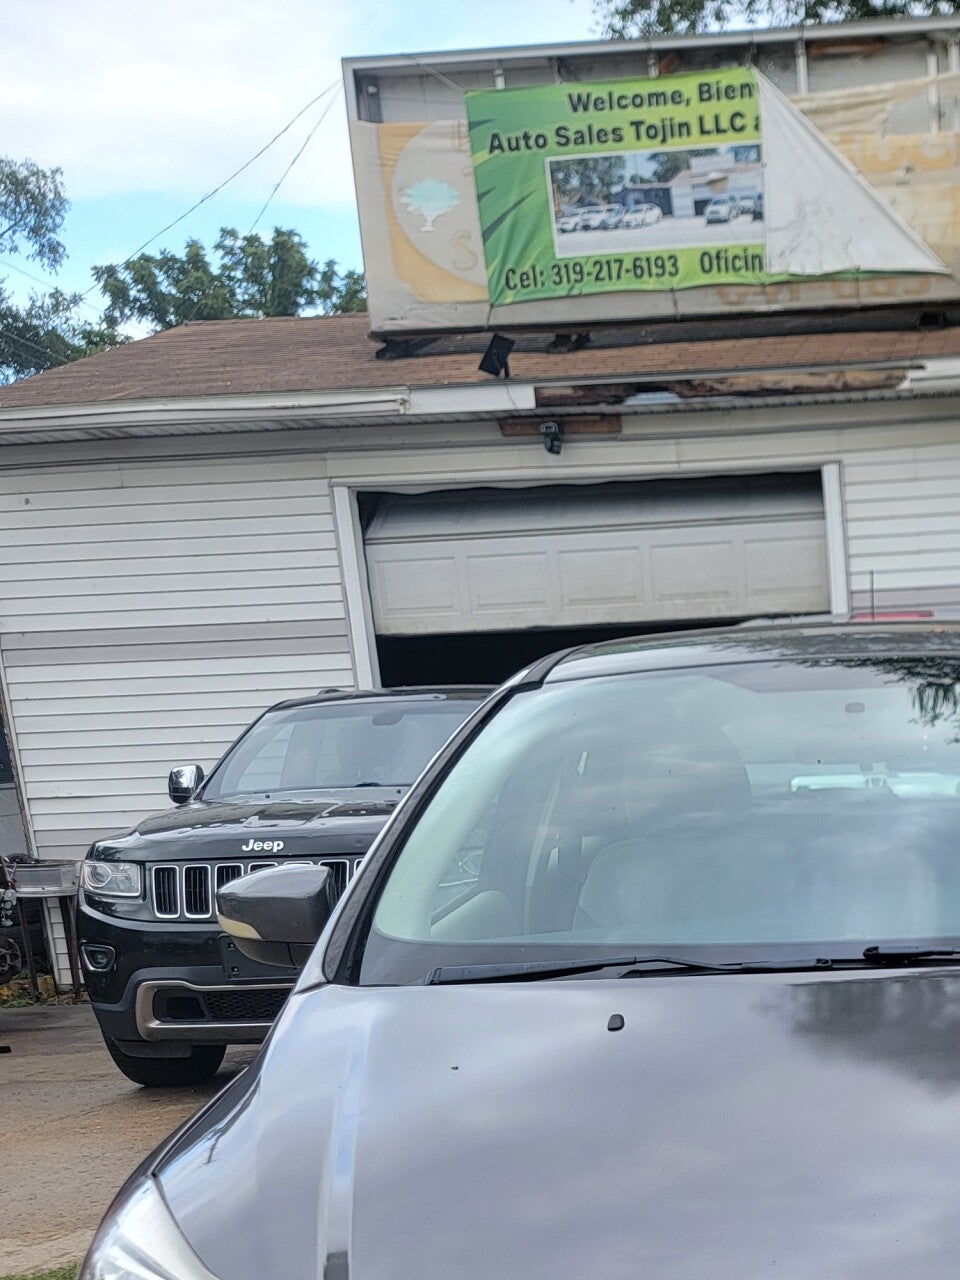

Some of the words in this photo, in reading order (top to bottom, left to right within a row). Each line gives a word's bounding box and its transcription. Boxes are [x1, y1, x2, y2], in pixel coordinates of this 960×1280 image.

[568, 89, 691, 113] Welcome,
[698, 79, 760, 102] Bien
[488, 130, 548, 154] Auto
[555, 123, 624, 147] Sales
[630, 117, 691, 144] Tojin
[699, 112, 746, 136] LLC
[505, 267, 545, 290] Cel:
[552, 254, 680, 285] 319-217-6193
[241, 839, 285, 852] Jeep
